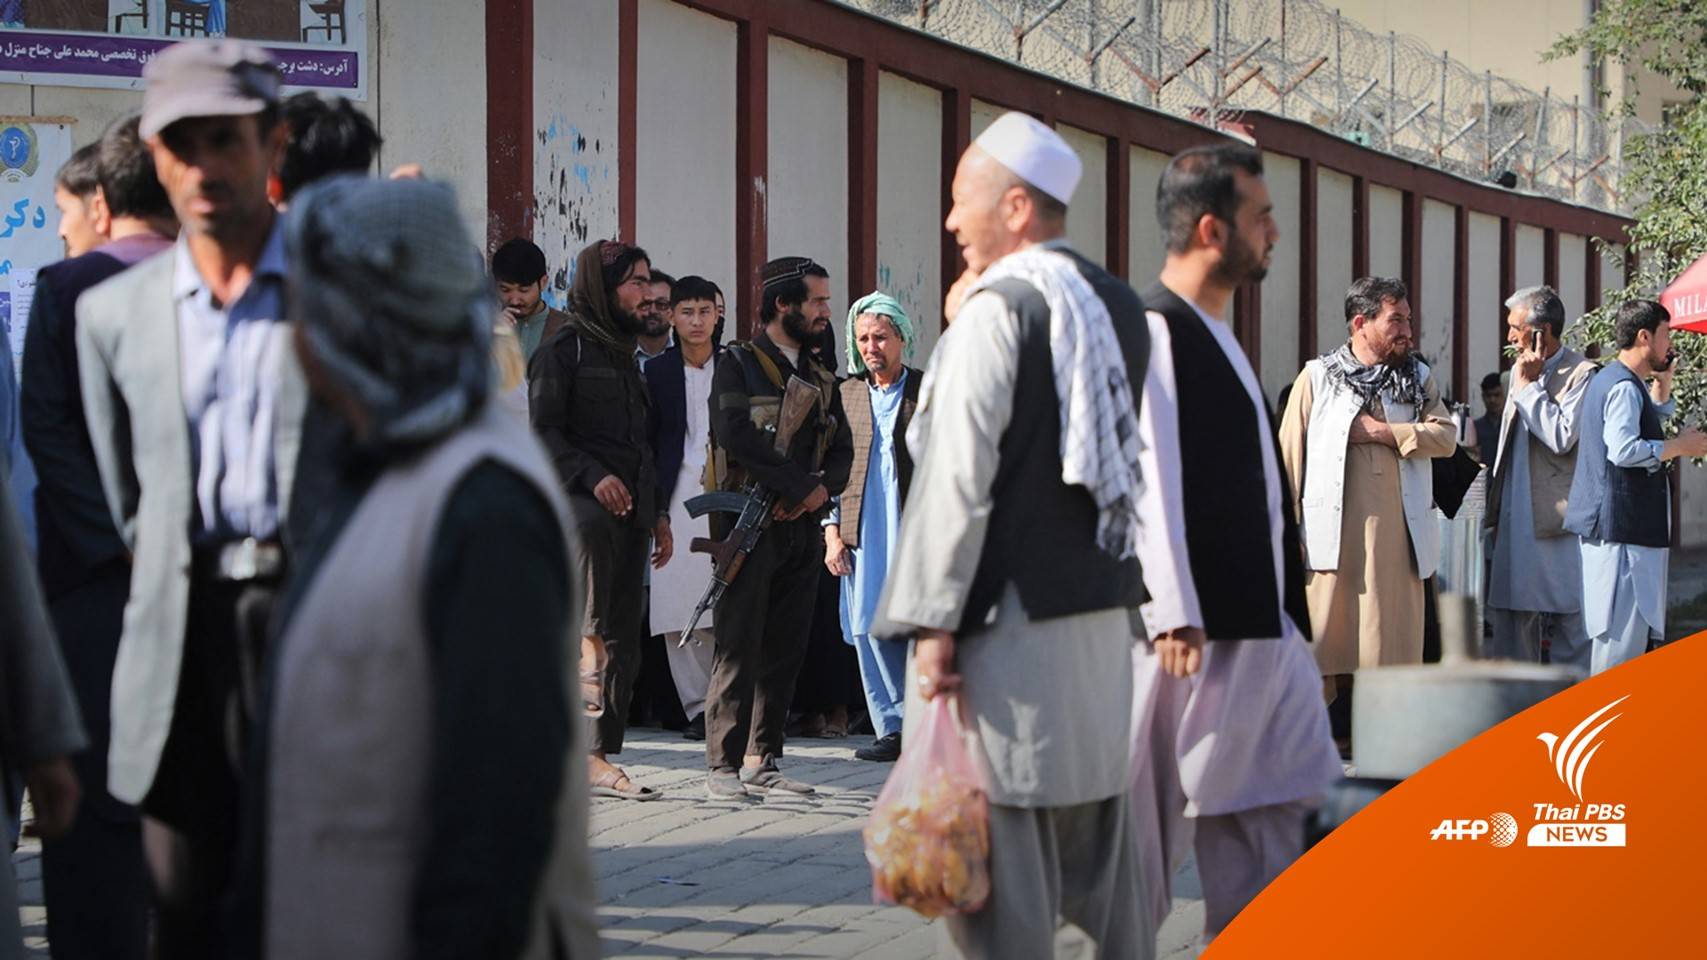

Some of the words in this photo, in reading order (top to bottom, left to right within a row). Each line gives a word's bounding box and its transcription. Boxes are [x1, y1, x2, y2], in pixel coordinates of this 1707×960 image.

[4, 42, 26, 58] منزل
[28, 43, 52, 58] جناح
[74, 48, 99, 58] محمد
[297, 60, 318, 71] دشت
